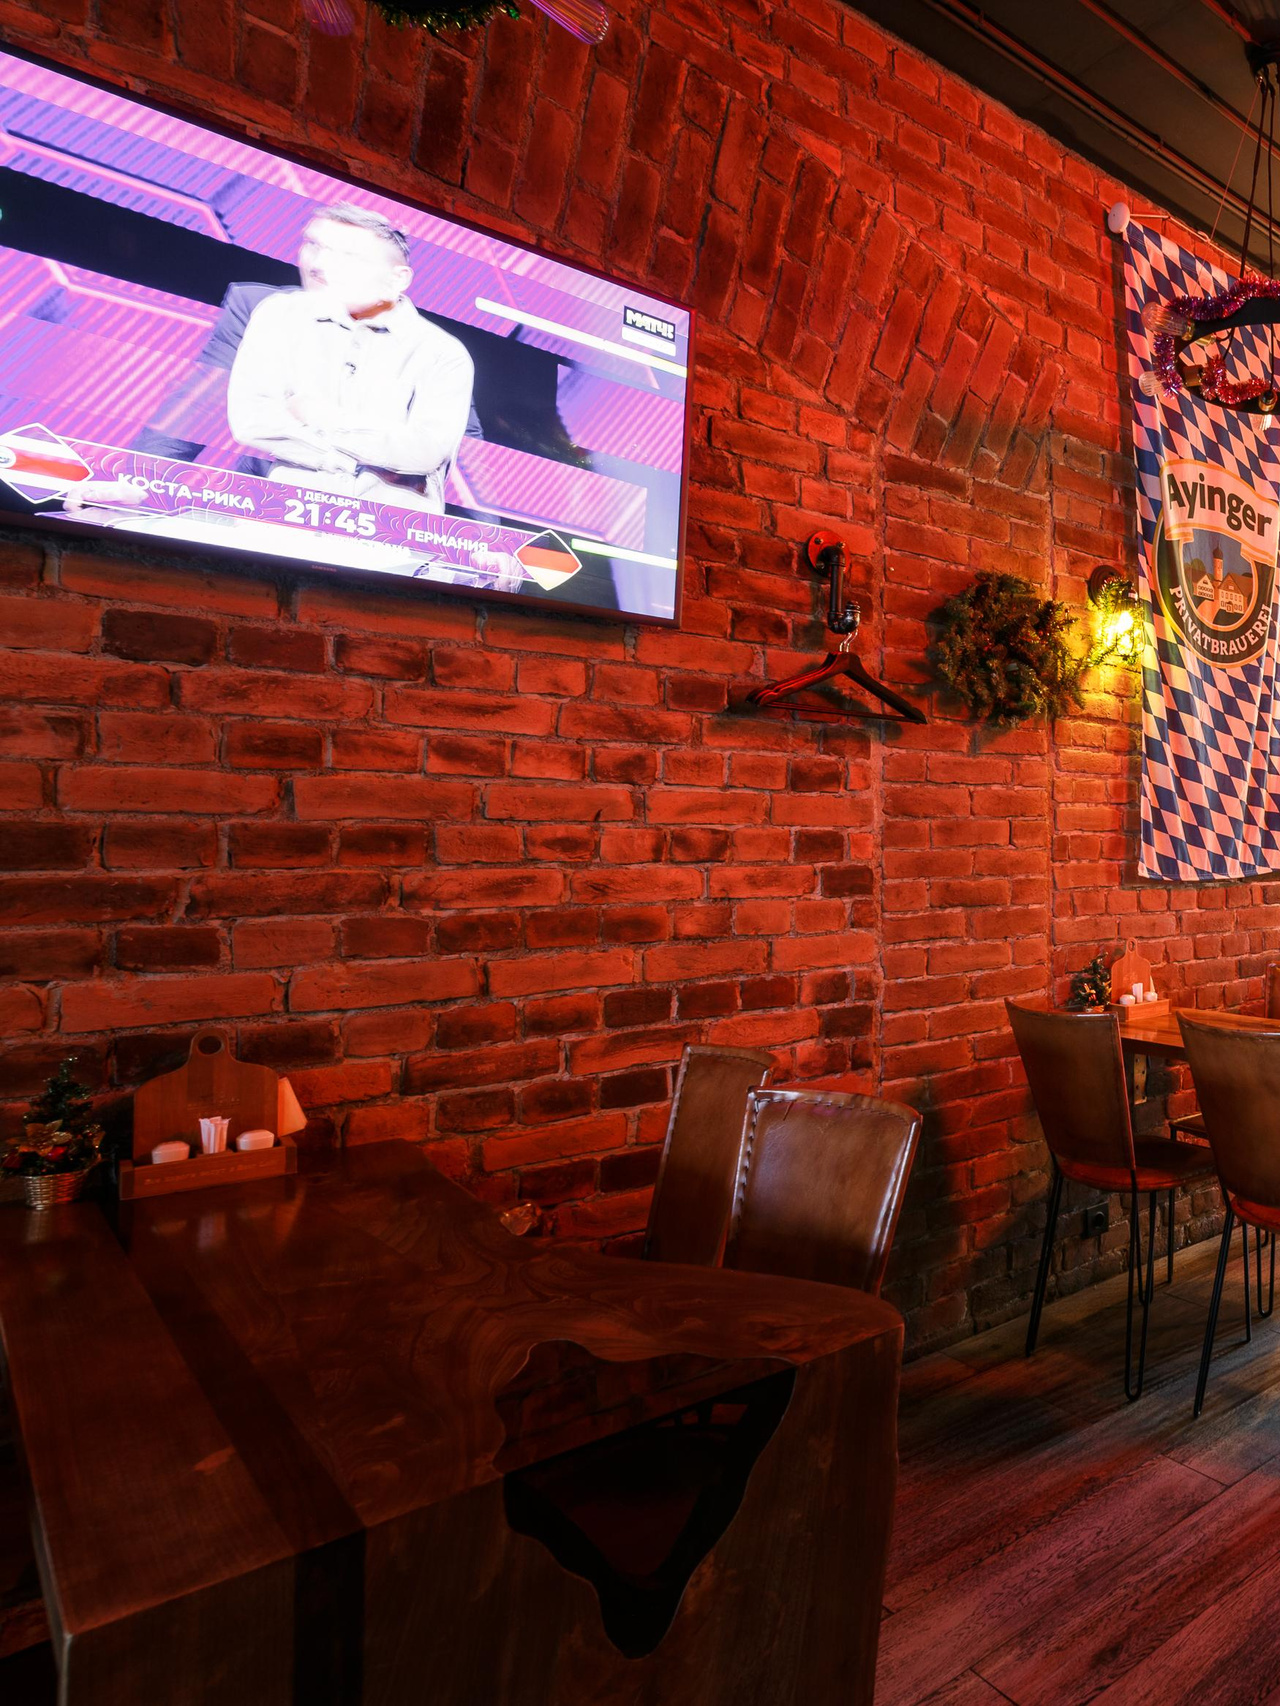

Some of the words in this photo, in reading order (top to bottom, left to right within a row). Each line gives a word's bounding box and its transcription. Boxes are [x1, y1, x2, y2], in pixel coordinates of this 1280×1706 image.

[117, 473, 256, 511] КОСТА-РИКА
[296, 489, 302, 499] 1
[304, 490, 361, 510] ДЕКАБРЯ
[1168, 472, 1273, 537] Ayinger
[283, 498, 377, 537] 21:45
[406, 527, 489, 553] ГЕРМАНИЯ
[1169, 584, 1271, 656] PRIVATBRAUEREI
